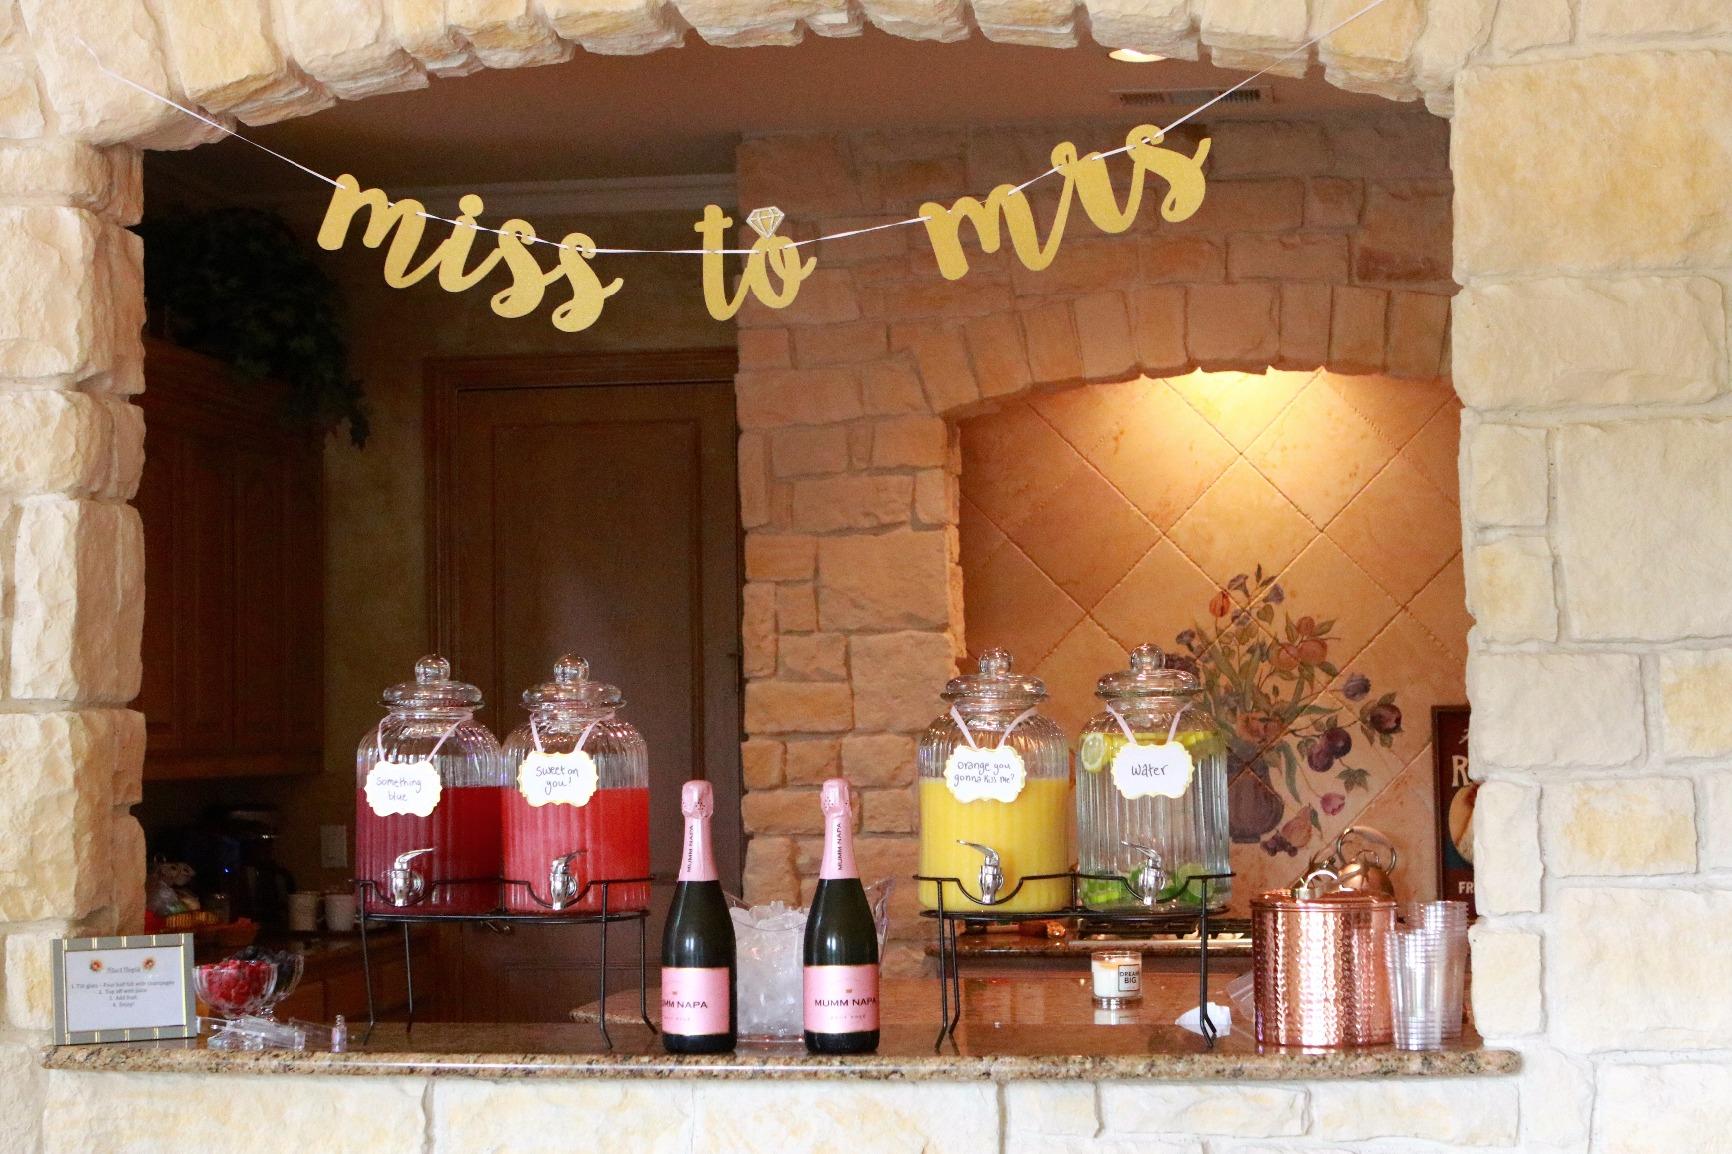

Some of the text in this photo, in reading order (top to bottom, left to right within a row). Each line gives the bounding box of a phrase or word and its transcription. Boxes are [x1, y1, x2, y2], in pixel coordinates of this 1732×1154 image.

[317, 124, 1212, 332] miss to mrs
[567, 767, 579, 777] on
[993, 762, 1011, 776] you
[953, 774, 982, 787] gonna
[387, 791, 408, 802] blue
[676, 1000, 708, 1009] NAPA
[814, 996, 877, 1007] MUMM NAPA
